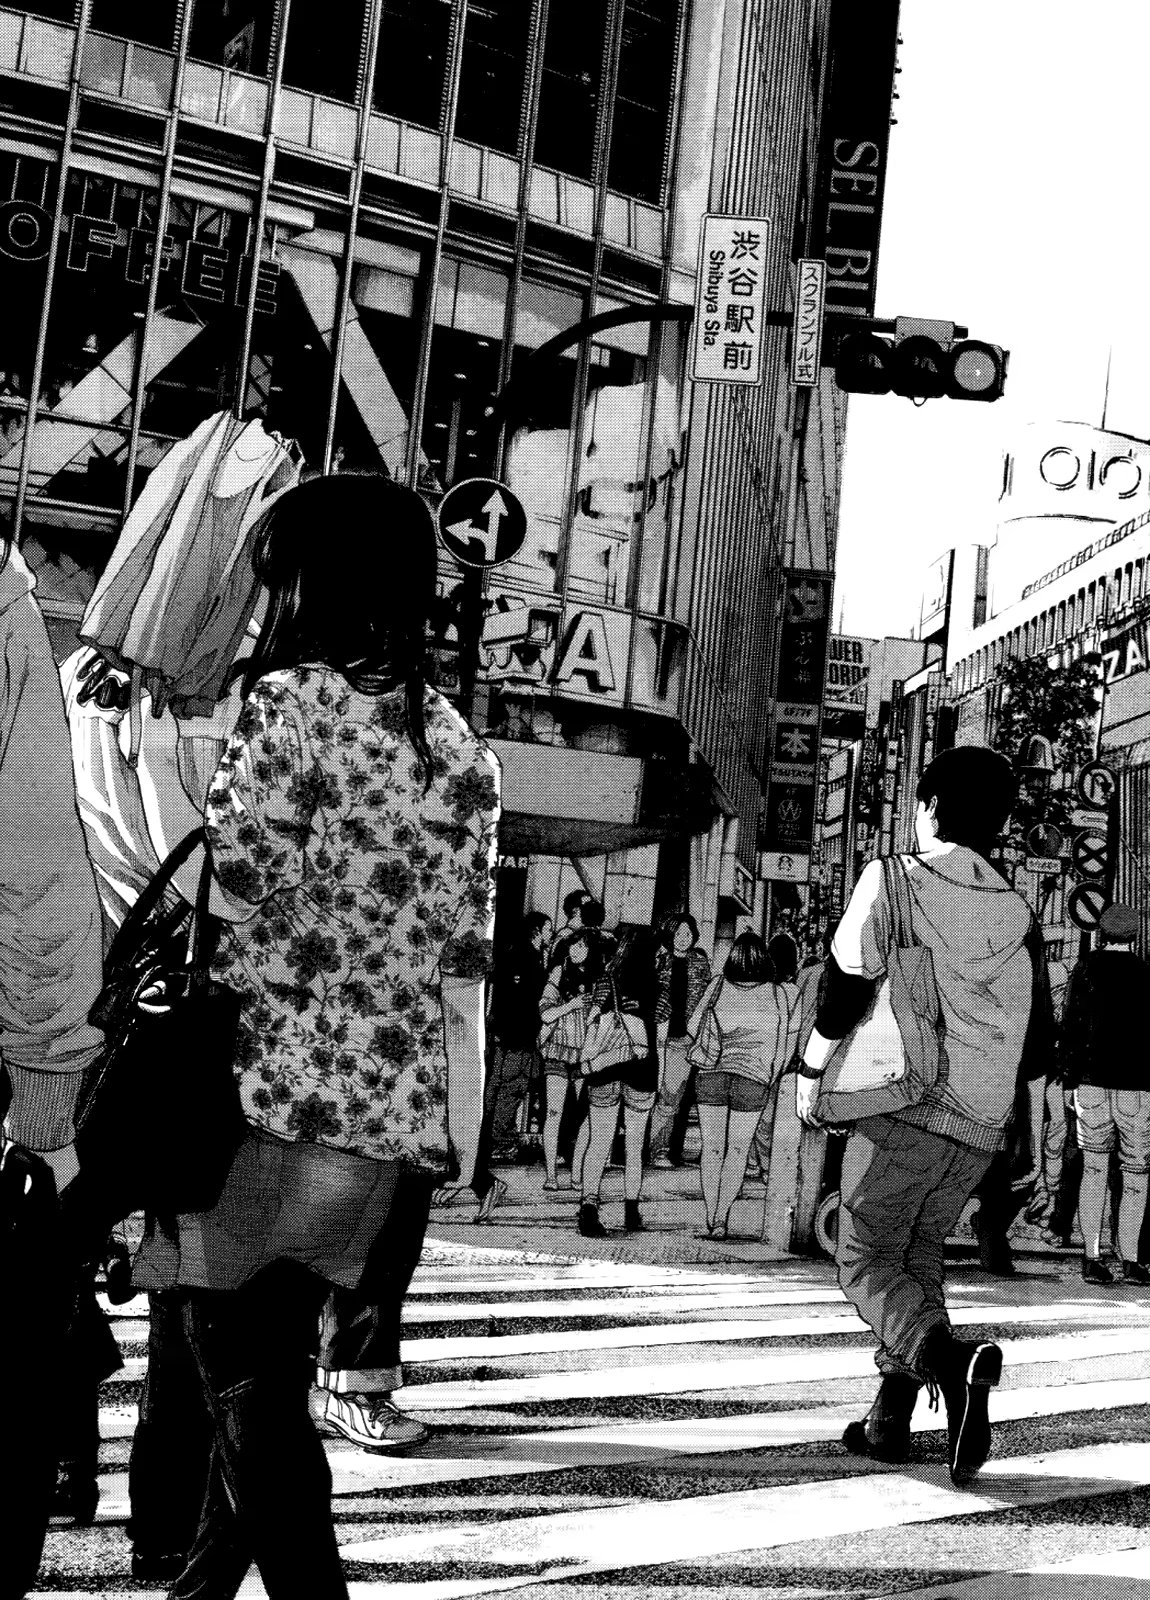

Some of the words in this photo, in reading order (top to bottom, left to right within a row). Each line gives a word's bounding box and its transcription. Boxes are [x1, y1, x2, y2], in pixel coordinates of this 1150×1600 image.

[826, 137, 880, 234] SEL
[704, 250, 726, 315] Shibuya
[723, 230, 761, 371] 渋谷駅前
[797, 266, 818, 379] スクランブル式
[703, 320, 721, 351] Sta.
[780, 727, 811, 759] 本
